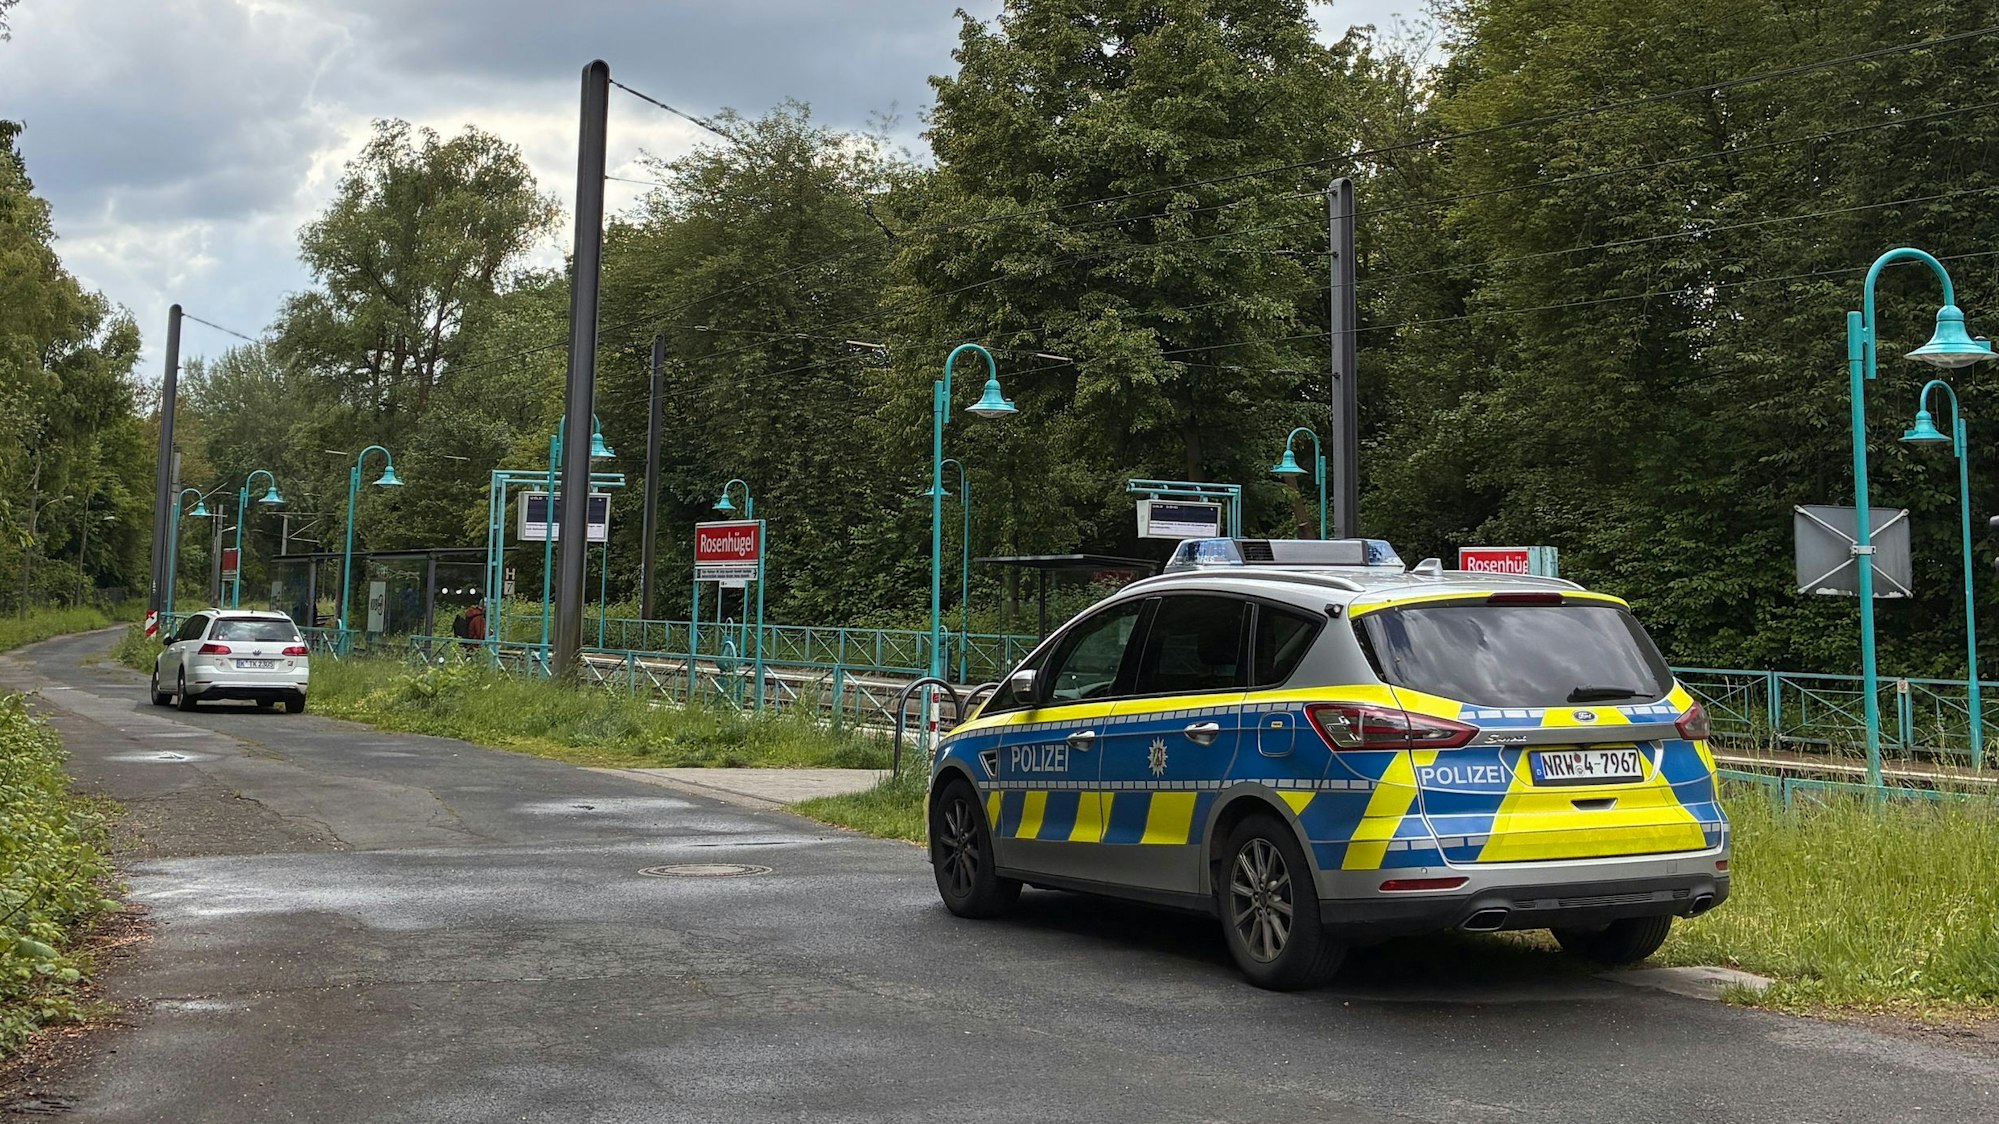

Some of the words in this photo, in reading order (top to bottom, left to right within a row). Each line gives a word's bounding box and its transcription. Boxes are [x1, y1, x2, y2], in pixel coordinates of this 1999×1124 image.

[700, 530, 755, 557] Rosenhügel
[505, 567, 516, 580] H
[1467, 555, 1529, 575] Rosenhüg
[507, 582, 513, 593] 7
[1011, 744, 1069, 772] POLIZEI
[1536, 768, 1542, 776] D
[1542, 753, 1575, 777] NRW
[1584, 752, 1637, 775] 4-7967
[1421, 765, 1506, 785] POLIZEI
